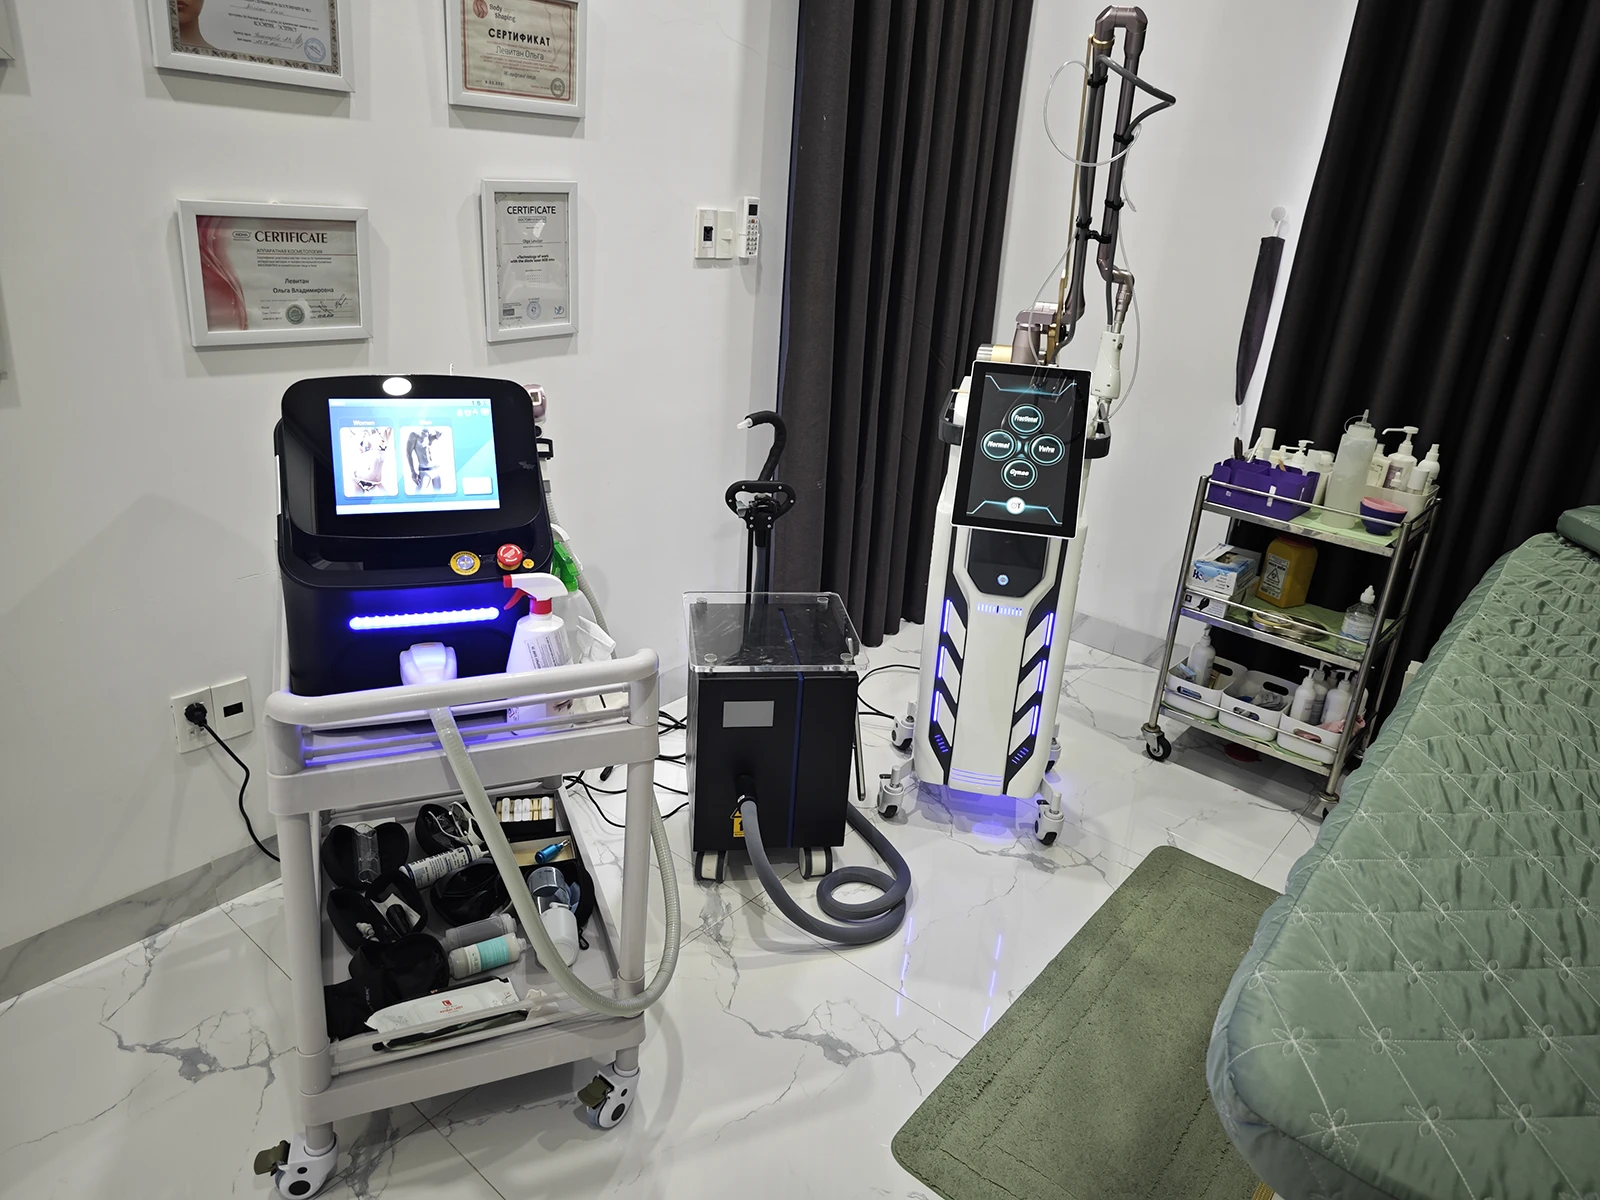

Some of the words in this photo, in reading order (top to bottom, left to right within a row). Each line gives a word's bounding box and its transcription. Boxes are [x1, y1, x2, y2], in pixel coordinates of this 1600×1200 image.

[488, 28, 550, 47] СЕРТИФИКАТ
[496, 45, 524, 57] Левитан
[525, 50, 544, 60] Ольга
[506, 206, 556, 215] CERTIFICATE
[255, 230, 328, 243] CERTIFICATE
[987, 440, 1010, 449] Normal
